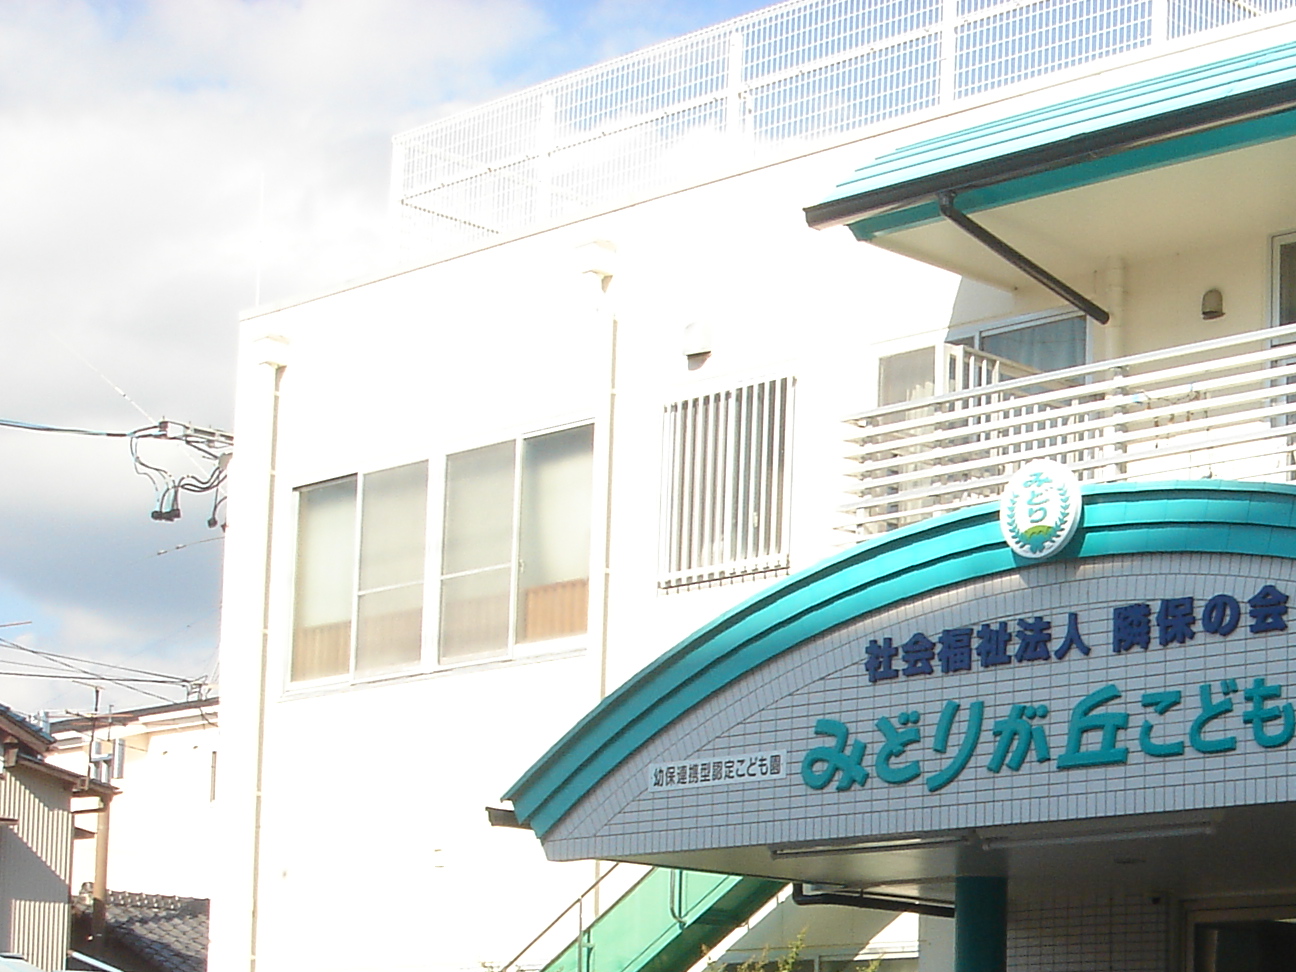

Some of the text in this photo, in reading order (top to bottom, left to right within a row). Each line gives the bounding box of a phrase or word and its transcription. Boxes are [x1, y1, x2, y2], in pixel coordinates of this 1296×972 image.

[1023, 471, 1053, 524] みどり
[864, 584, 1290, 683] 社会福祉法人 隣保の会
[653, 754, 781, 787] 幼保連携型認定こども園
